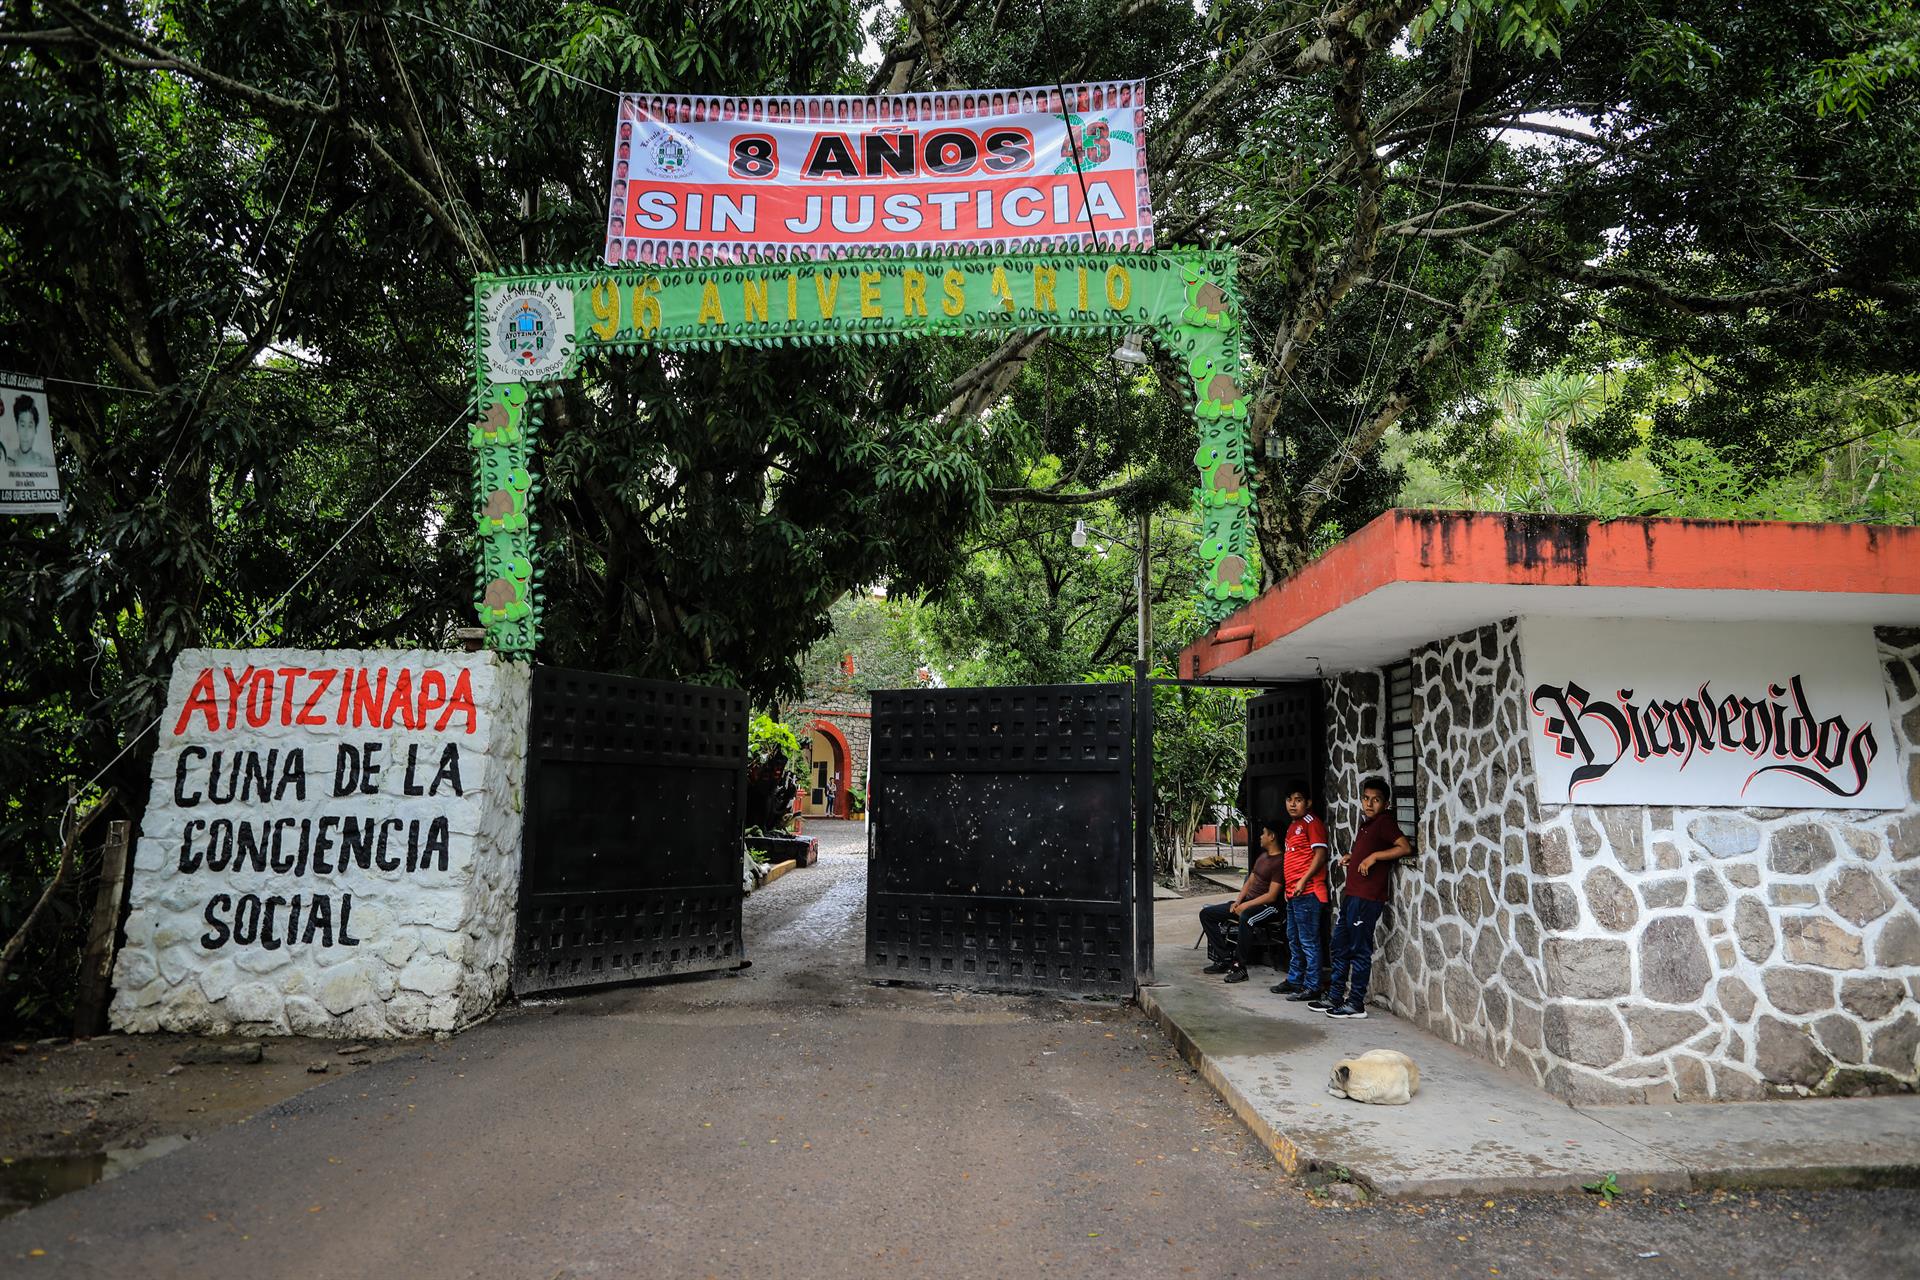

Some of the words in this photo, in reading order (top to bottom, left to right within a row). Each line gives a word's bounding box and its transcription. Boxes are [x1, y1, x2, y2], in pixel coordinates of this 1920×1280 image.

[730, 135, 778, 180] 8
[801, 126, 1034, 180] AÑOS
[1061, 121, 1111, 164] 43
[635, 191, 756, 233] SIN
[785, 182, 1125, 234] JUSTICIA
[489, 294, 512, 322] Escuela
[513, 287, 545, 299] Normal
[546, 293, 566, 320] Rural
[592, 274, 662, 340] 96
[698, 264, 1131, 325] ANIVERSARIO
[511, 367, 534, 377] ISIDRO
[174, 665, 477, 735] AYOTZINAPA
[1530, 674, 1878, 802] Bienvenidos
[174, 745, 306, 808] CUNA
[333, 742, 383, 798] DE
[403, 742, 463, 797] LA
[178, 816, 449, 877] CONCIENCIA
[201, 893, 360, 951] SOCIAL
